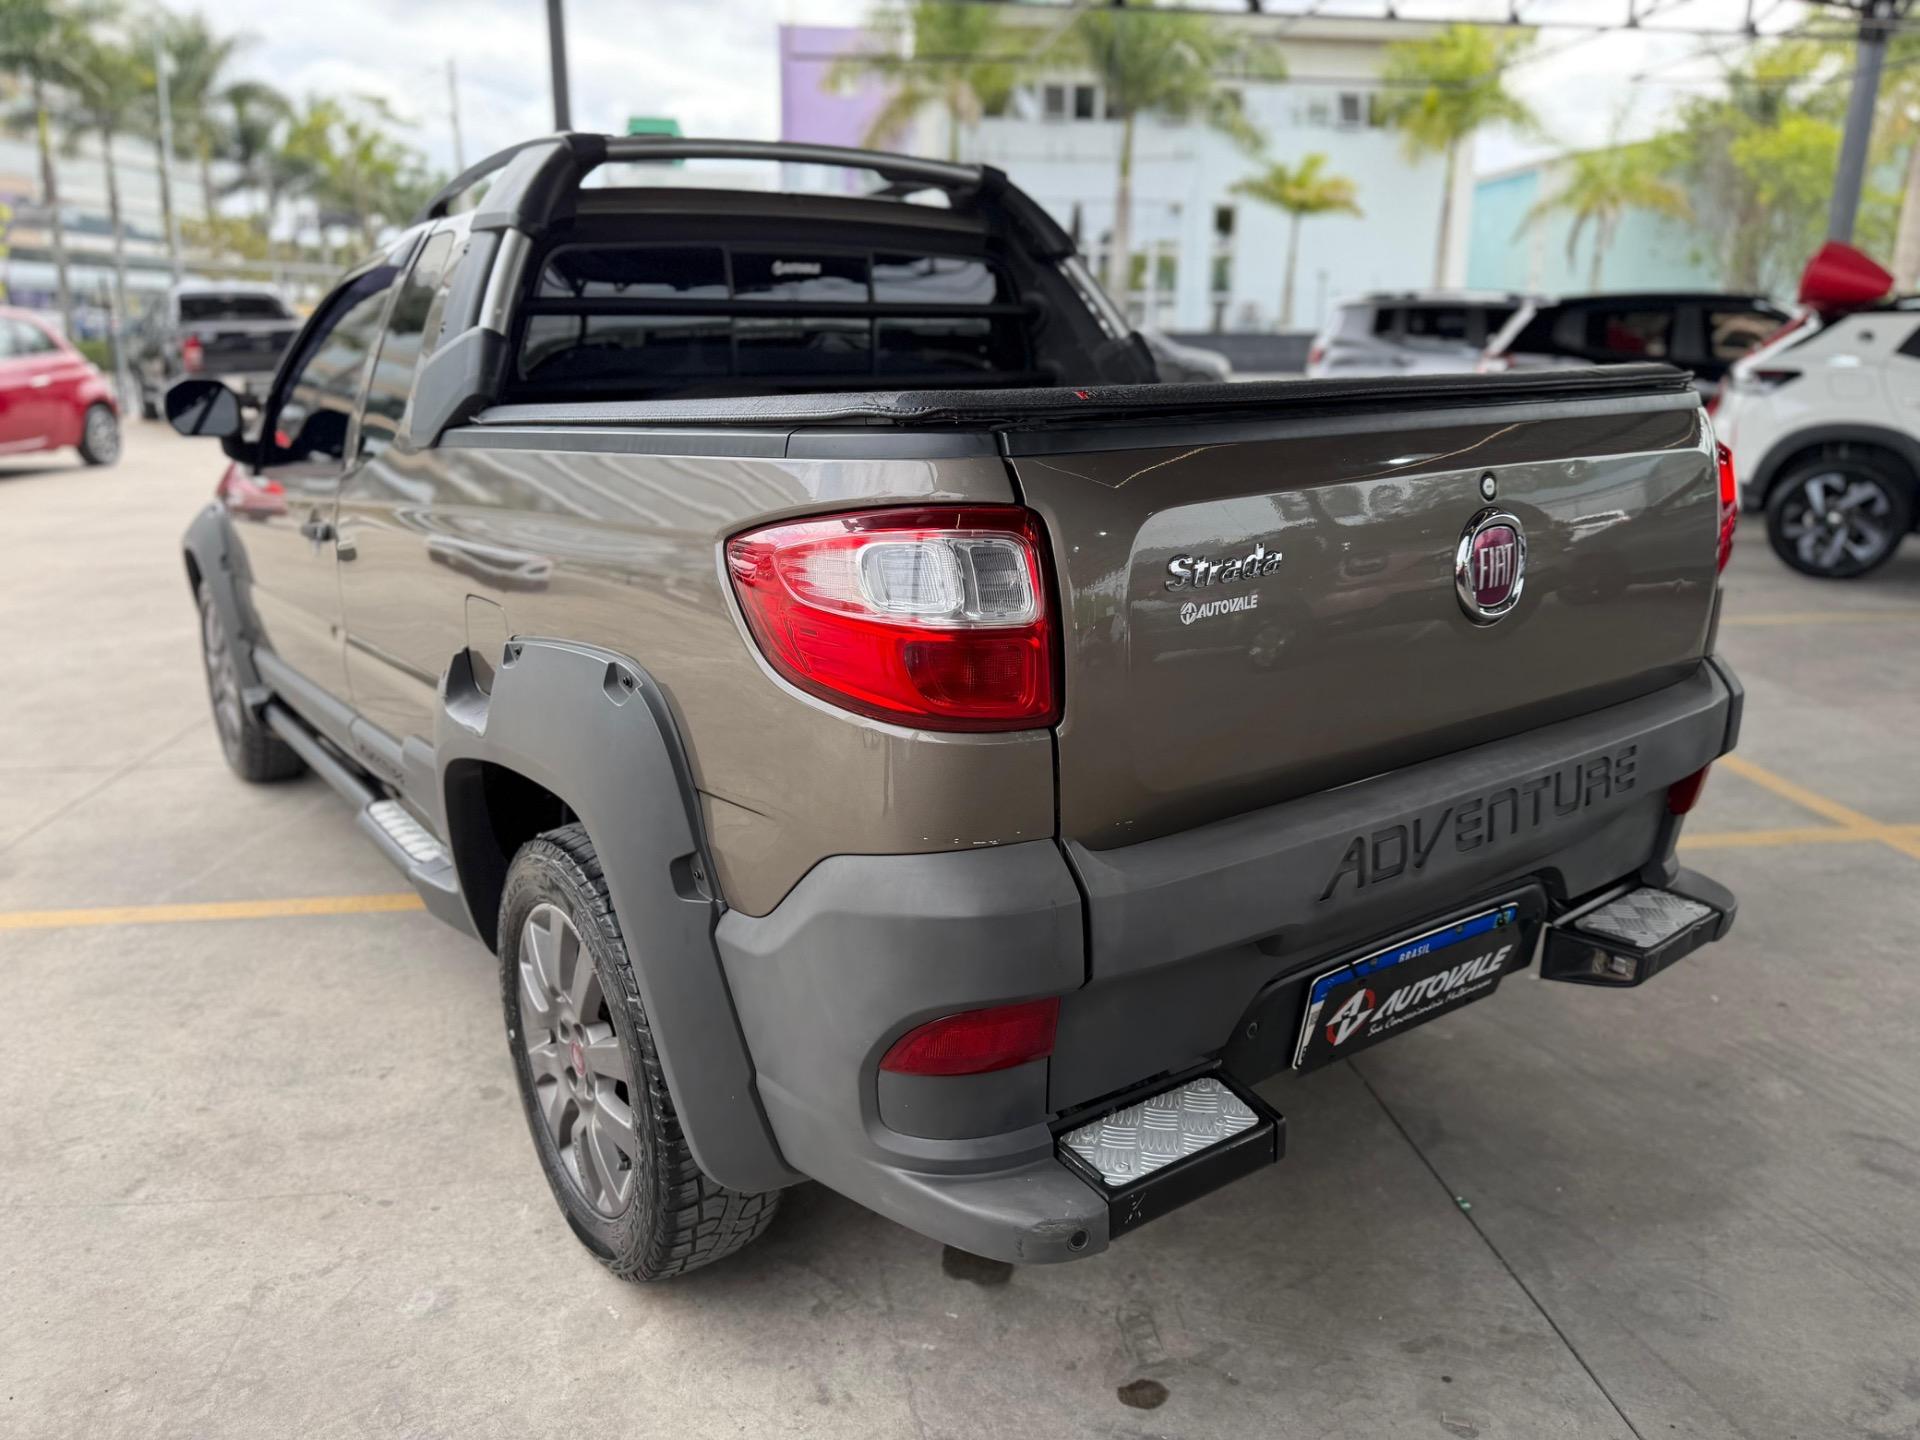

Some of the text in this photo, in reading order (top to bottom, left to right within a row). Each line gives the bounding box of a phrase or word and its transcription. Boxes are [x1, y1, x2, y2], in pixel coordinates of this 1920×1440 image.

[1165, 543, 1283, 592] Strada
[1478, 543, 1515, 590] FIAT
[1196, 594, 1258, 619] AUTOVALE
[1317, 744, 1637, 902] ADVENTURE
[1398, 943, 1431, 964] BRASIL
[1369, 944, 1513, 1022] AUTOVALE
